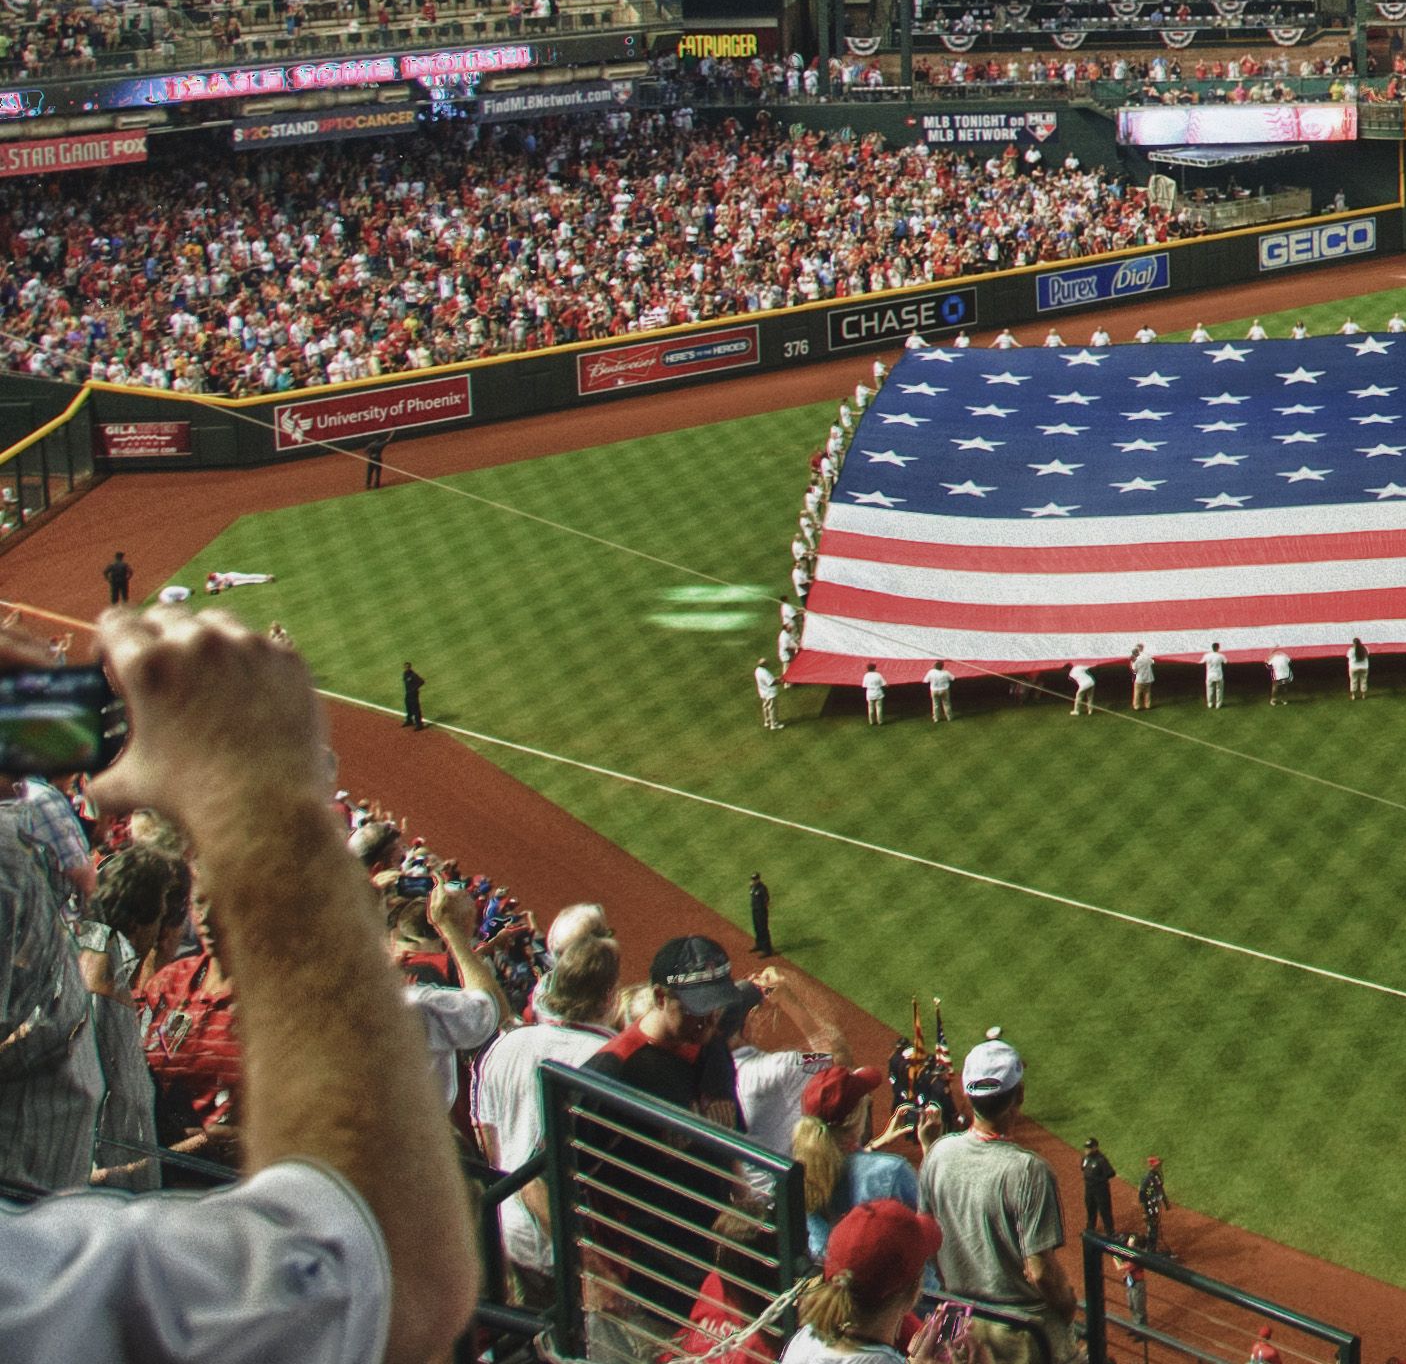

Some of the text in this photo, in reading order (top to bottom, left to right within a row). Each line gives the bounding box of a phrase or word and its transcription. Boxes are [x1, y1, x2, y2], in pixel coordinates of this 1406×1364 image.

[483, 88, 612, 115] FindMLBNetwork.com
[924, 115, 1025, 129] MLB TONIGHT on
[928, 129, 1019, 142] MLB NETWORK
[9, 137, 147, 170] STAR GAME FOX
[1260, 220, 1375, 269] GEICO
[1048, 261, 1157, 307] Purex Dial
[841, 300, 937, 341] CHASE
[587, 340, 748, 379] Budweiser HERE'S HEROES
[783, 340, 810, 358] 376
[316, 392, 463, 430] University of Phoenix
